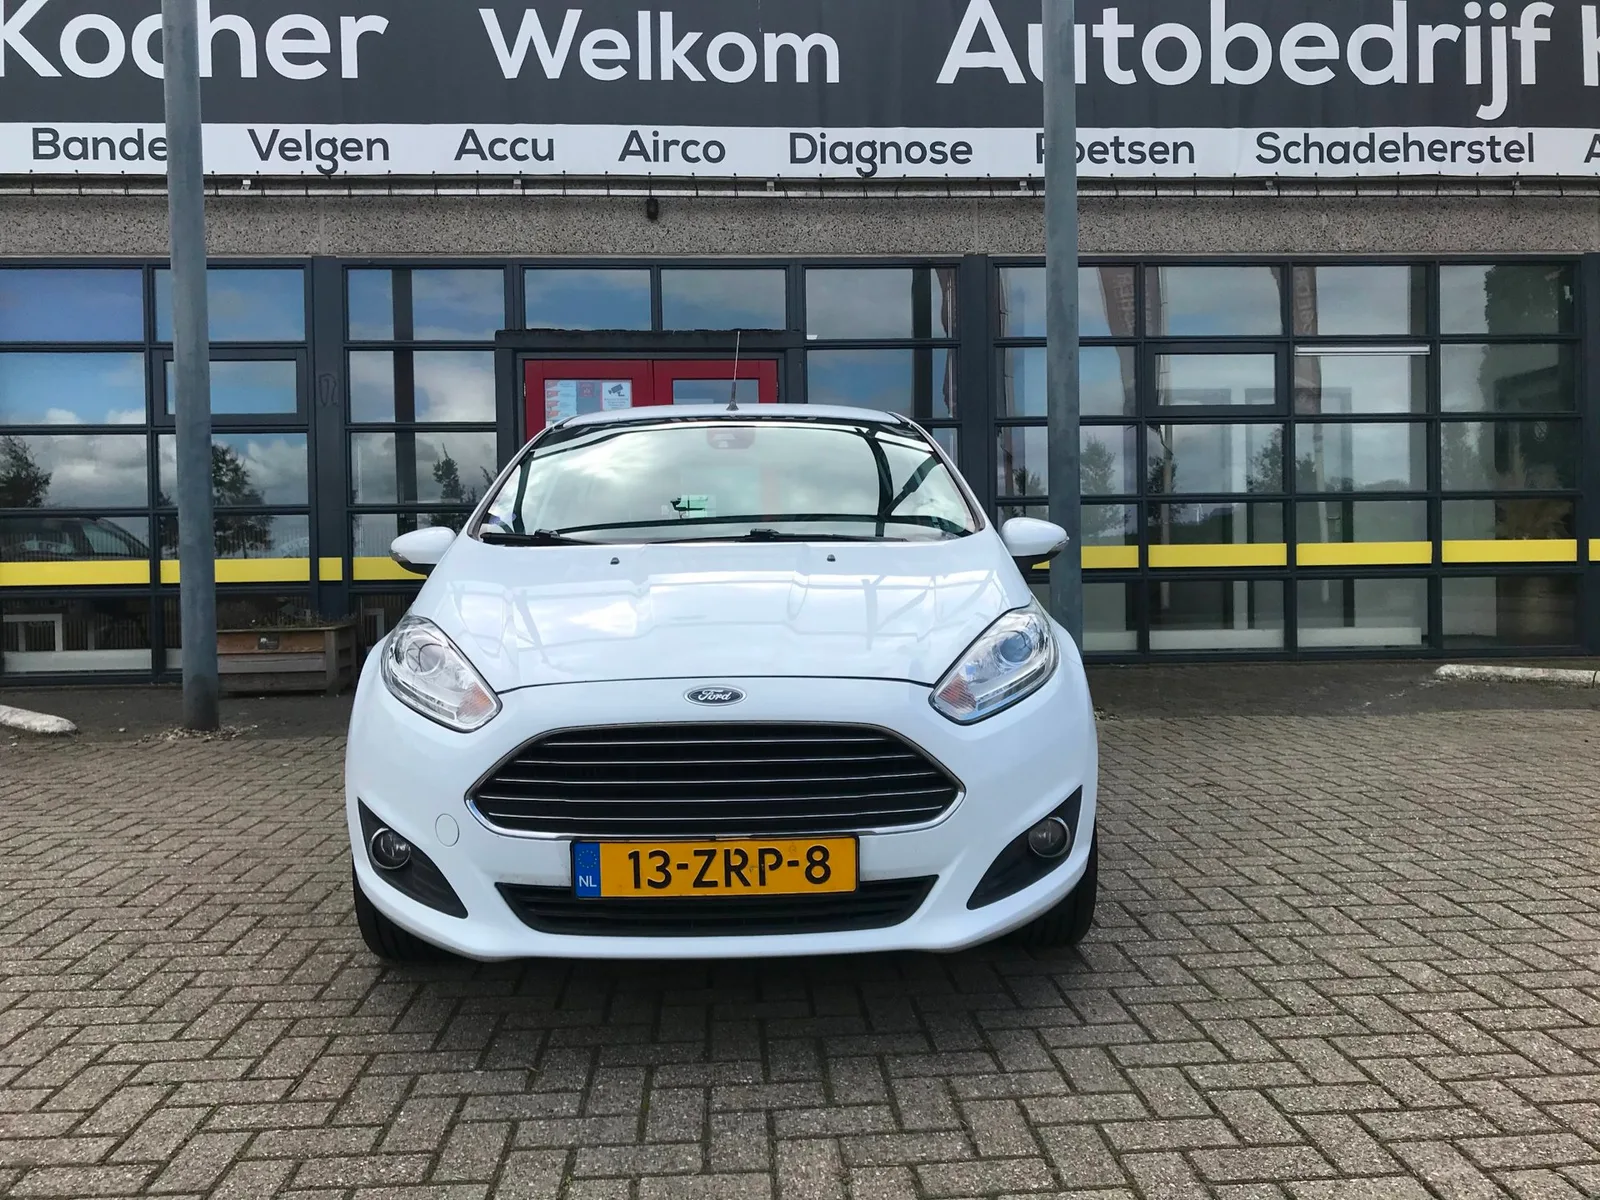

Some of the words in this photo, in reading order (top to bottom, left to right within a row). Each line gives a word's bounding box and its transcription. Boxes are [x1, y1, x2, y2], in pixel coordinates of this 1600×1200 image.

[0, 0, 389, 79] Kocher
[479, 9, 839, 83] Welkom
[32, 128, 168, 161] Bande
[247, 129, 390, 175] Velgen
[454, 129, 555, 162] Accu
[618, 130, 726, 164] Airco
[789, 132, 973, 178] Diagnose
[1255, 132, 1535, 165] Schadeherstel
[697, 689, 733, 701] Ford
[578, 875, 597, 888] NL
[628, 845, 831, 889] 13-ZRP-8
